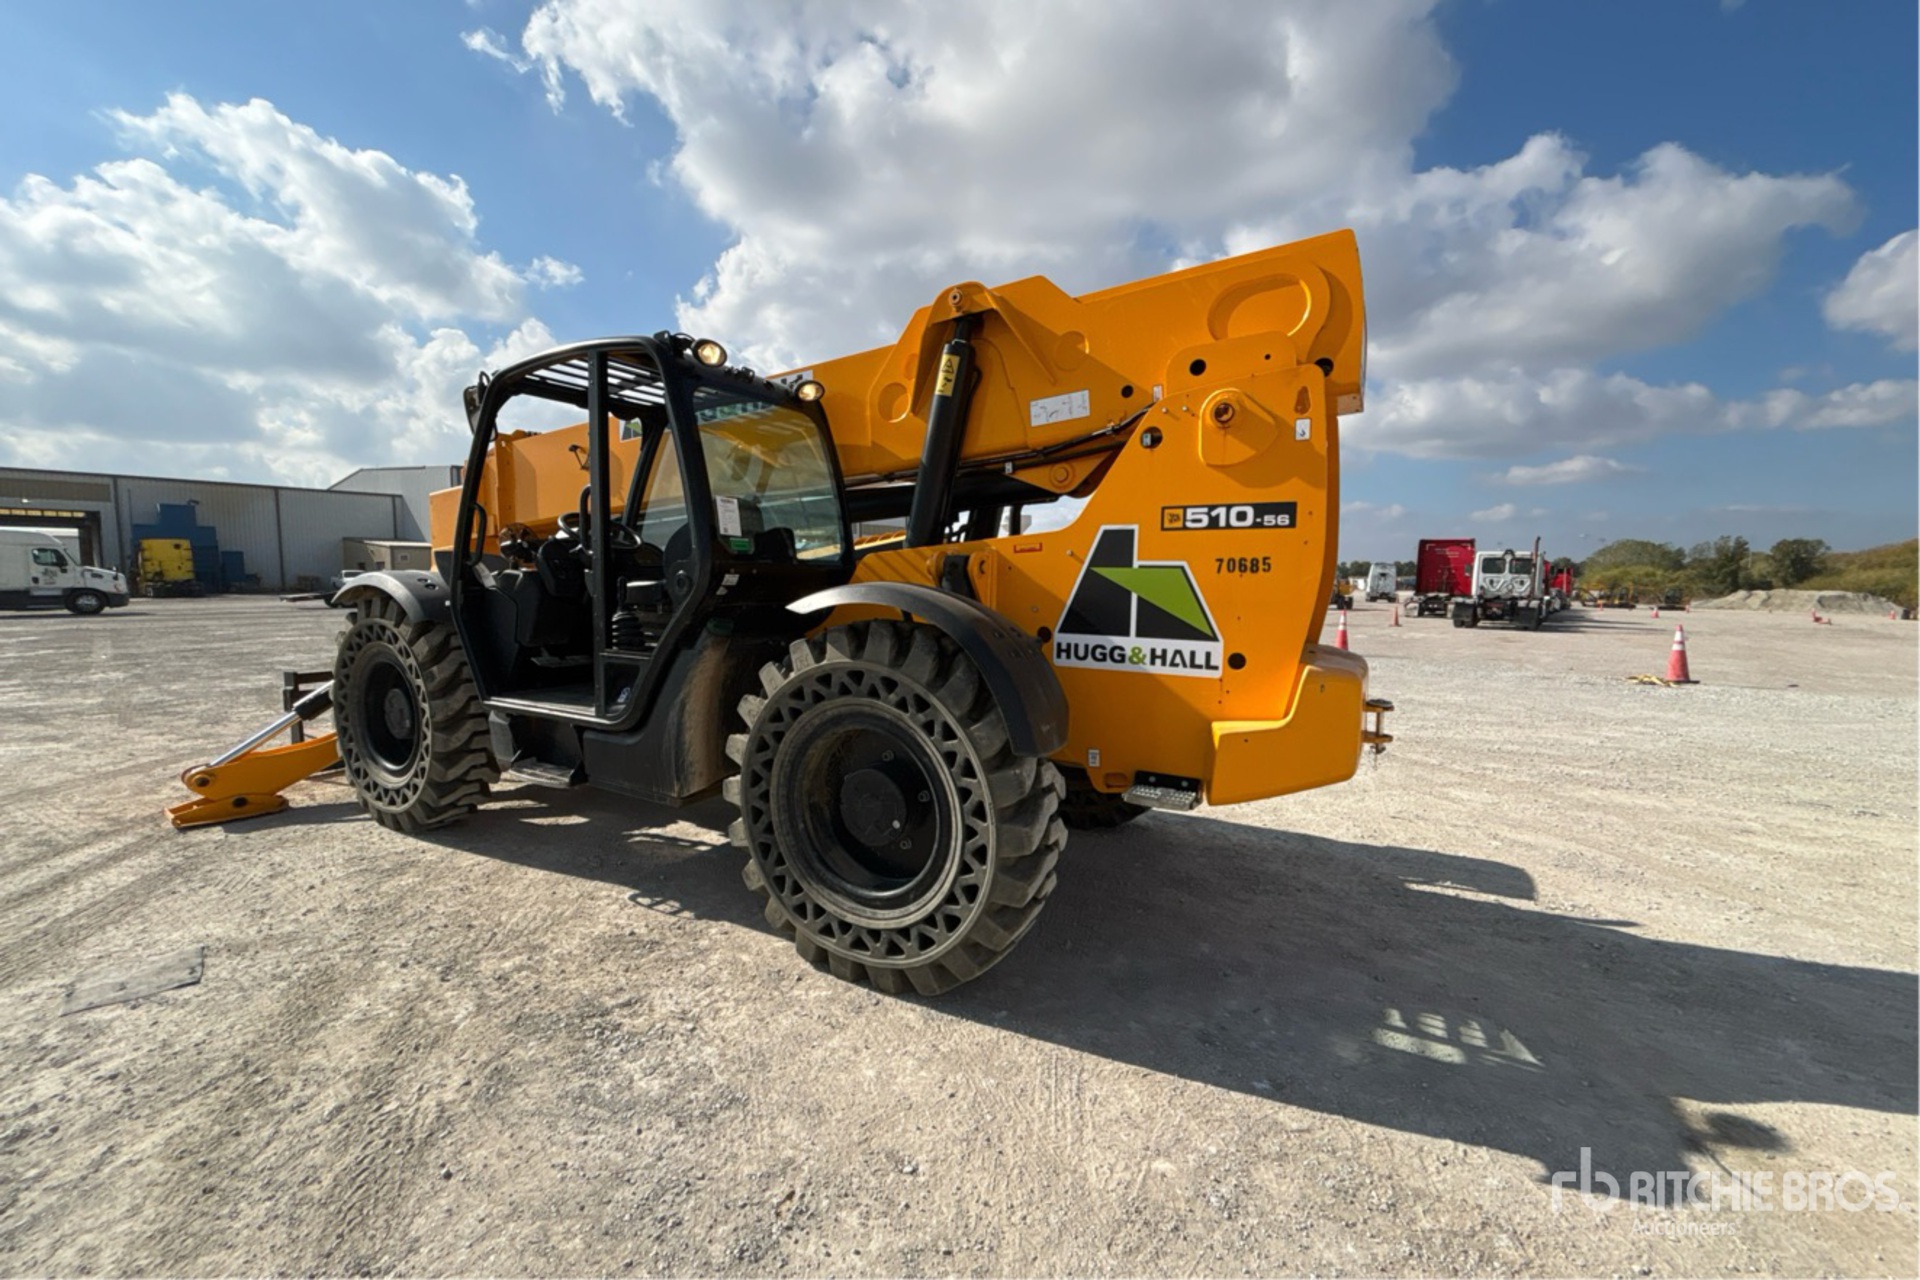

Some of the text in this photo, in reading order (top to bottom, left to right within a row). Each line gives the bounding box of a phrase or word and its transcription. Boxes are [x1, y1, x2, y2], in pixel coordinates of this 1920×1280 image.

[1185, 505, 1290, 528] 510-56
[1215, 556, 1272, 574] 70685
[1056, 642, 1219, 670] HUGG&HALL
